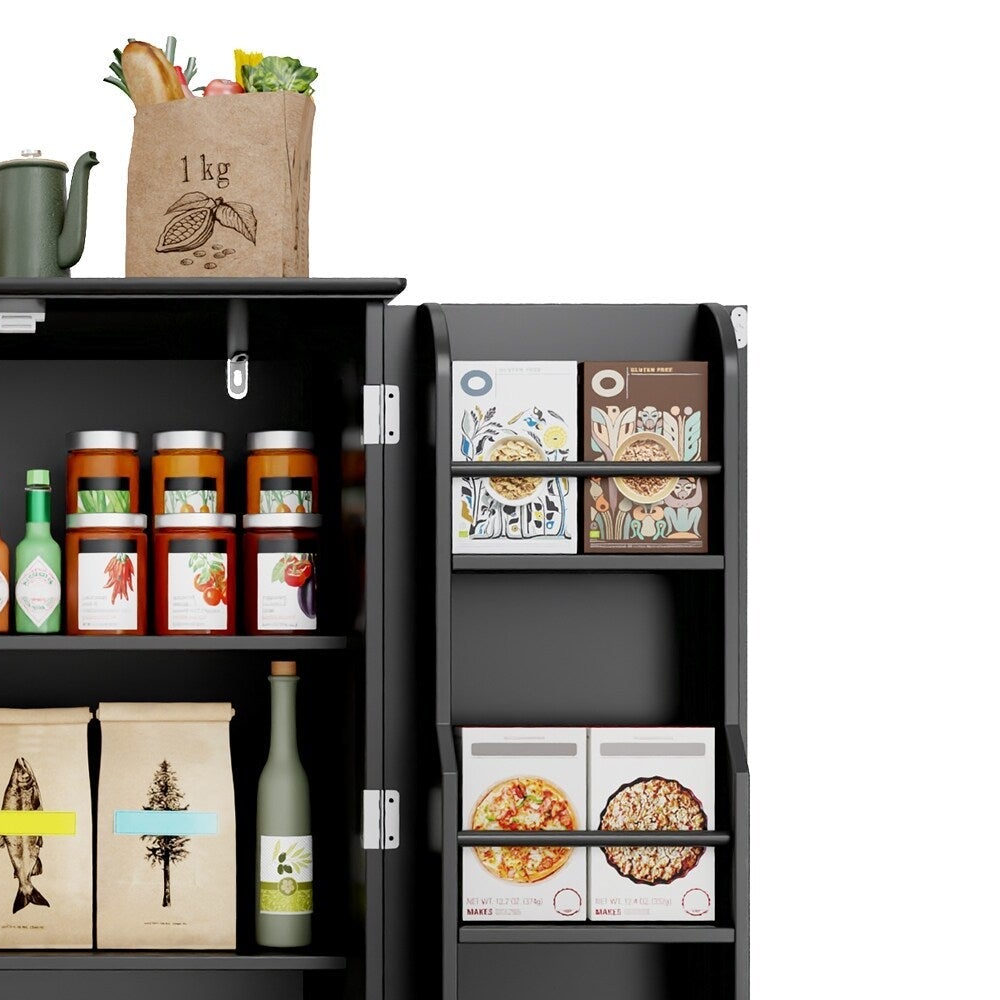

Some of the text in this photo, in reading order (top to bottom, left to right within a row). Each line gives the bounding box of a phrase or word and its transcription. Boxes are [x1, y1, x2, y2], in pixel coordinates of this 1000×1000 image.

[181, 153, 231, 189] 1 kg
[466, 908, 493, 916] MAKES
